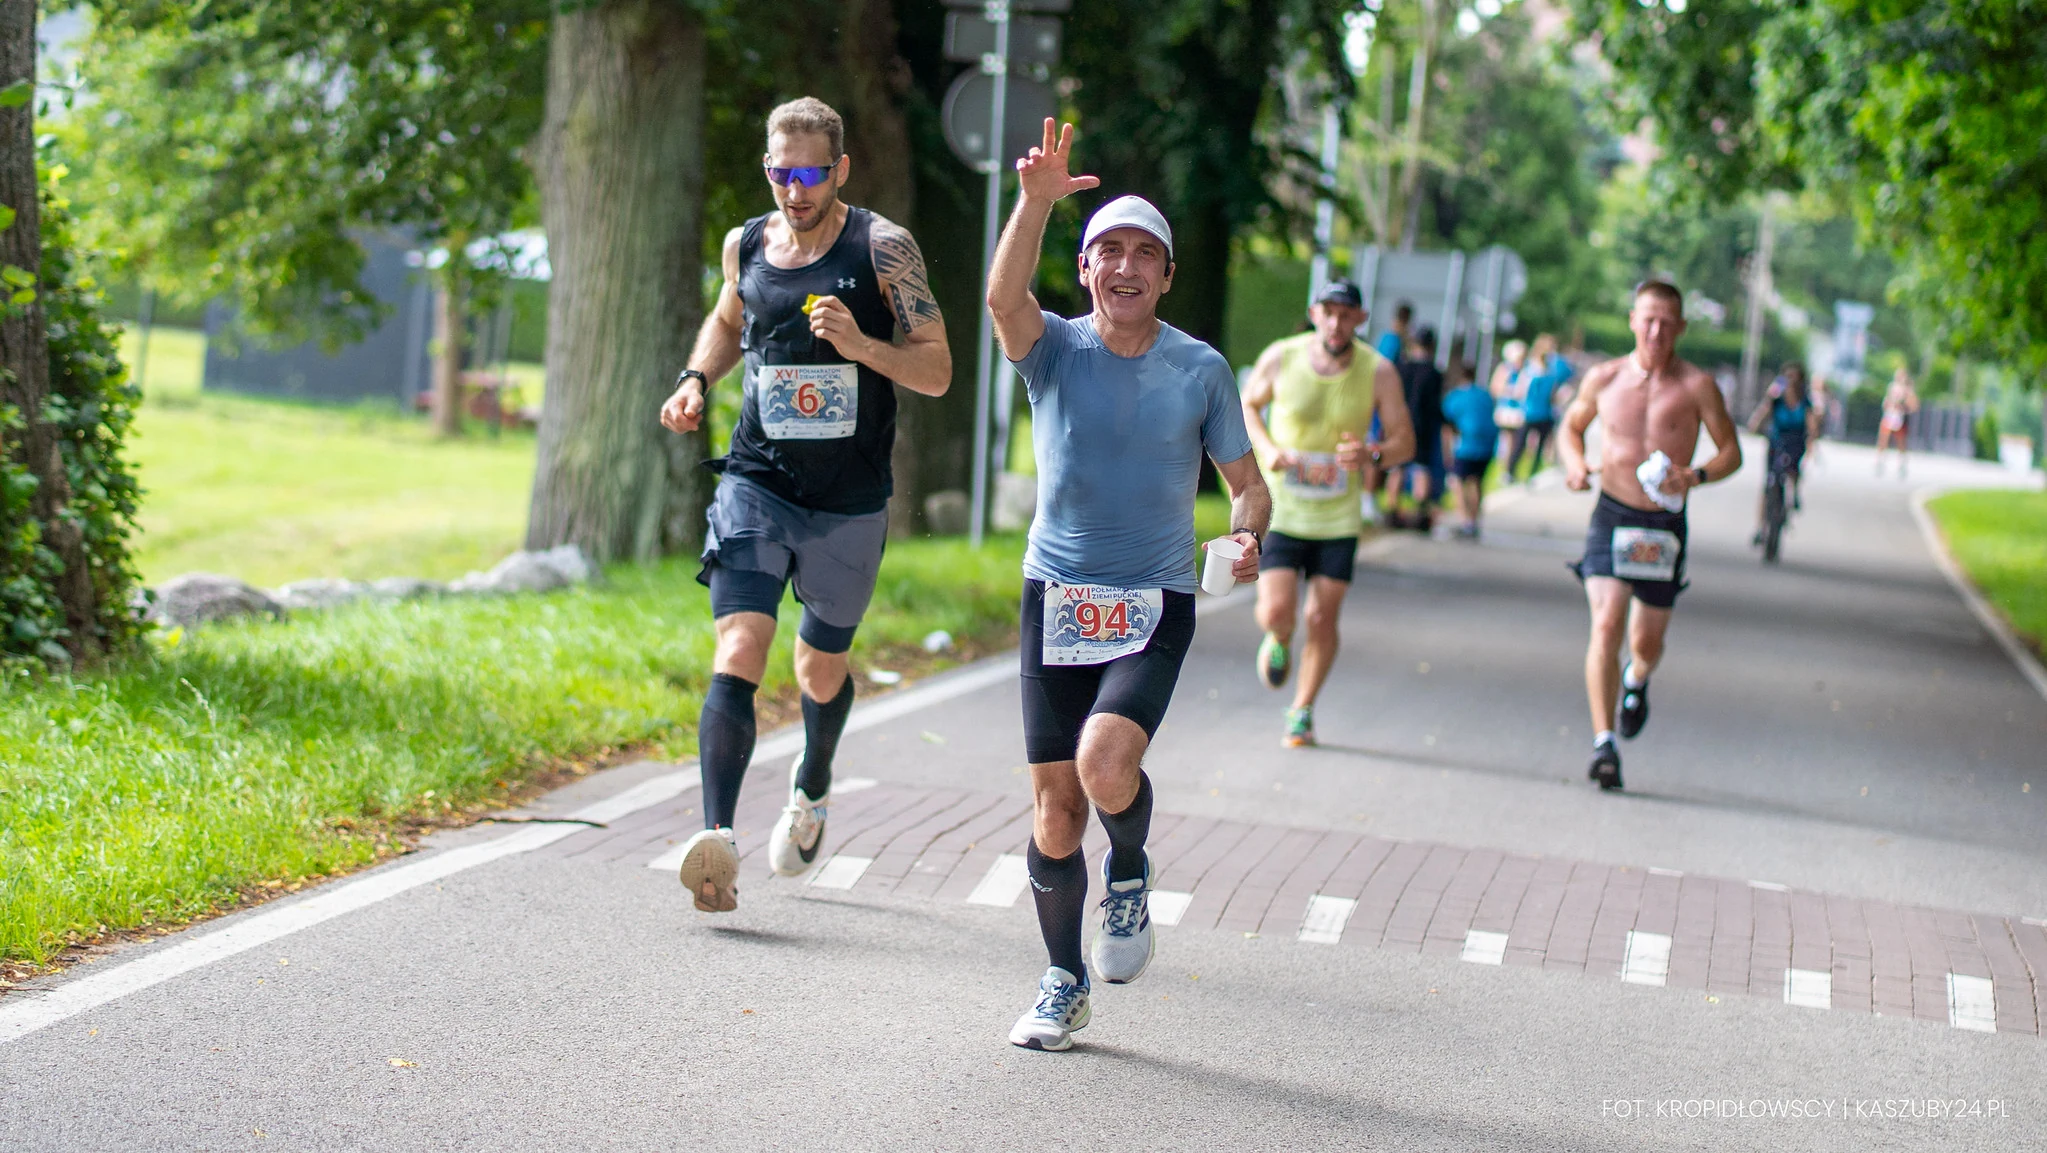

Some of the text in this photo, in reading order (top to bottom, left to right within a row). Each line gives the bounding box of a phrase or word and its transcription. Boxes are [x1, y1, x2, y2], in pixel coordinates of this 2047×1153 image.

[775, 368, 799, 380] XVI
[798, 383, 818, 414] 6
[1064, 587, 1091, 600] XVI
[1076, 602, 1130, 637] 94
